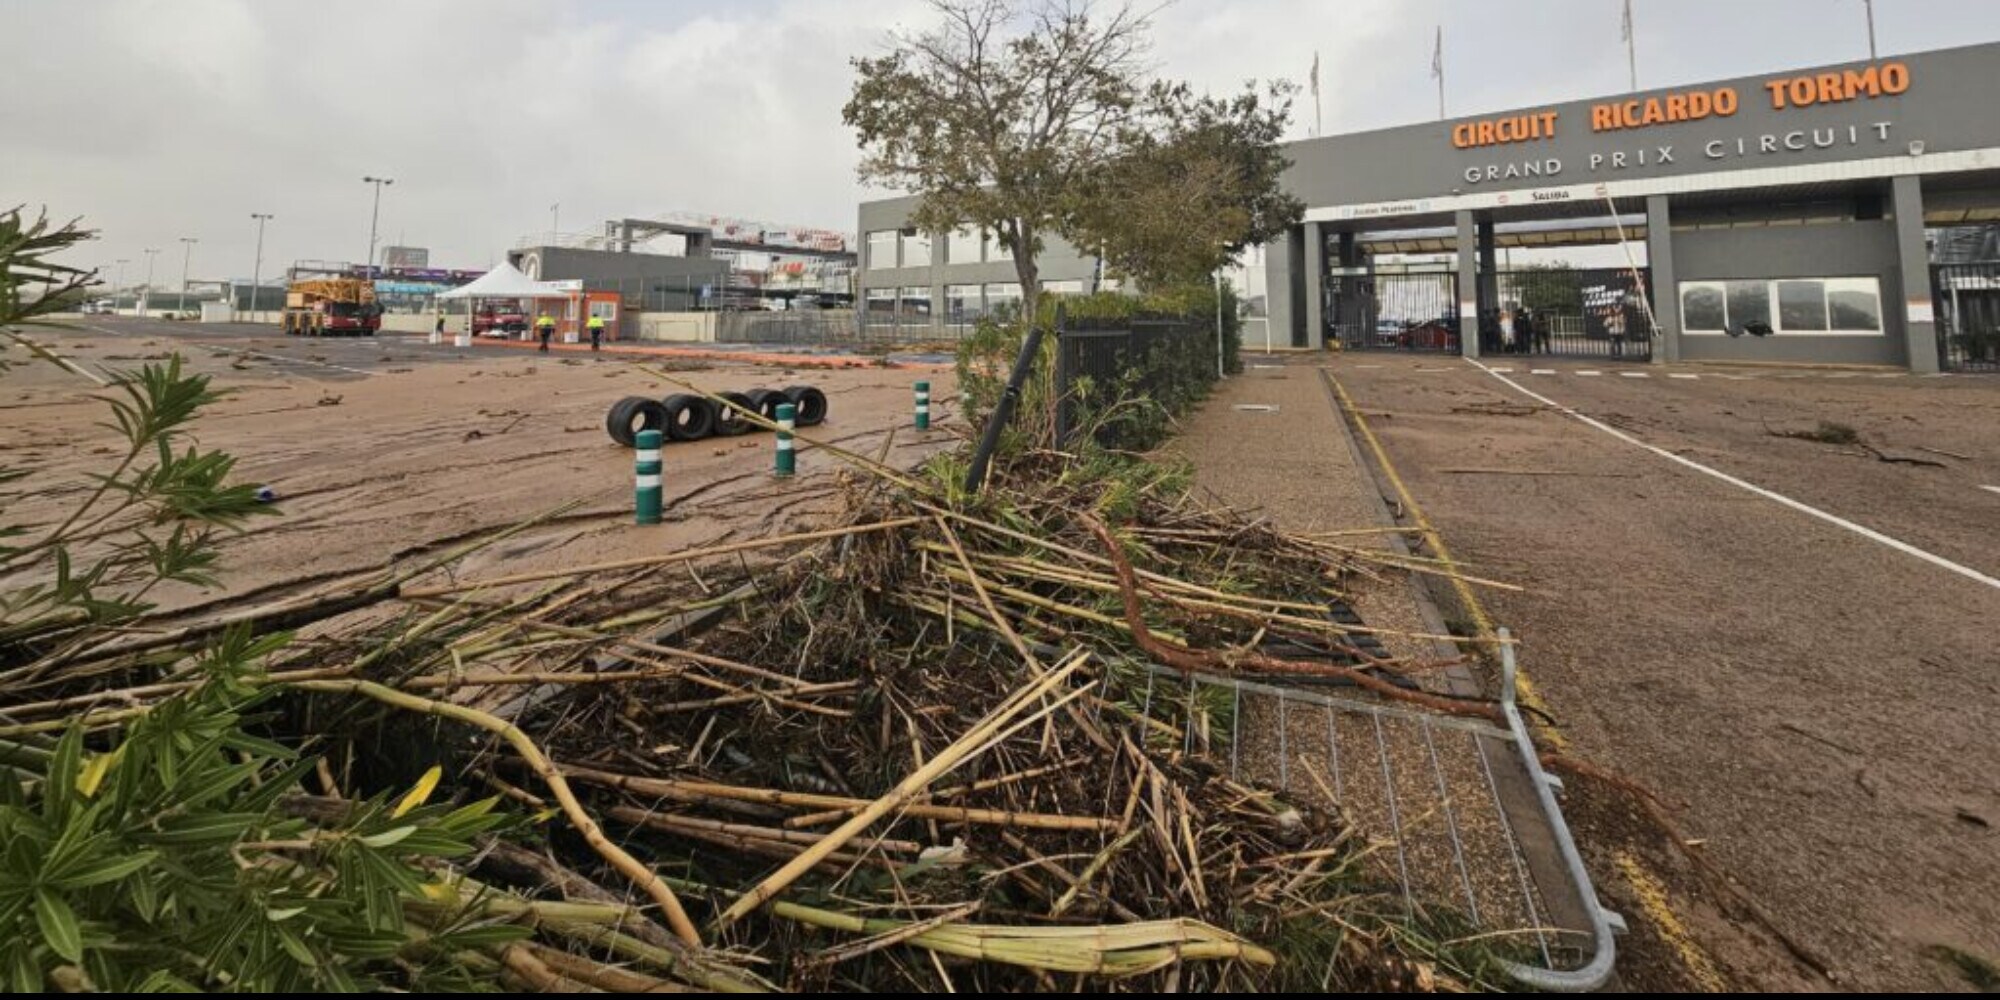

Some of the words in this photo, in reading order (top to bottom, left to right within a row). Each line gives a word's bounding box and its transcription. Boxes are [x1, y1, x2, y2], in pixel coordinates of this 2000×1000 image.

[1453, 112, 1557, 148] CIRCUIT
[1592, 87, 1737, 131] RICARDO
[1766, 63, 1910, 109] TORMO
[1465, 159, 1562, 183] GRAND
[1590, 147, 1674, 170] PRIX
[1706, 123, 1891, 158] CIRCUIT
